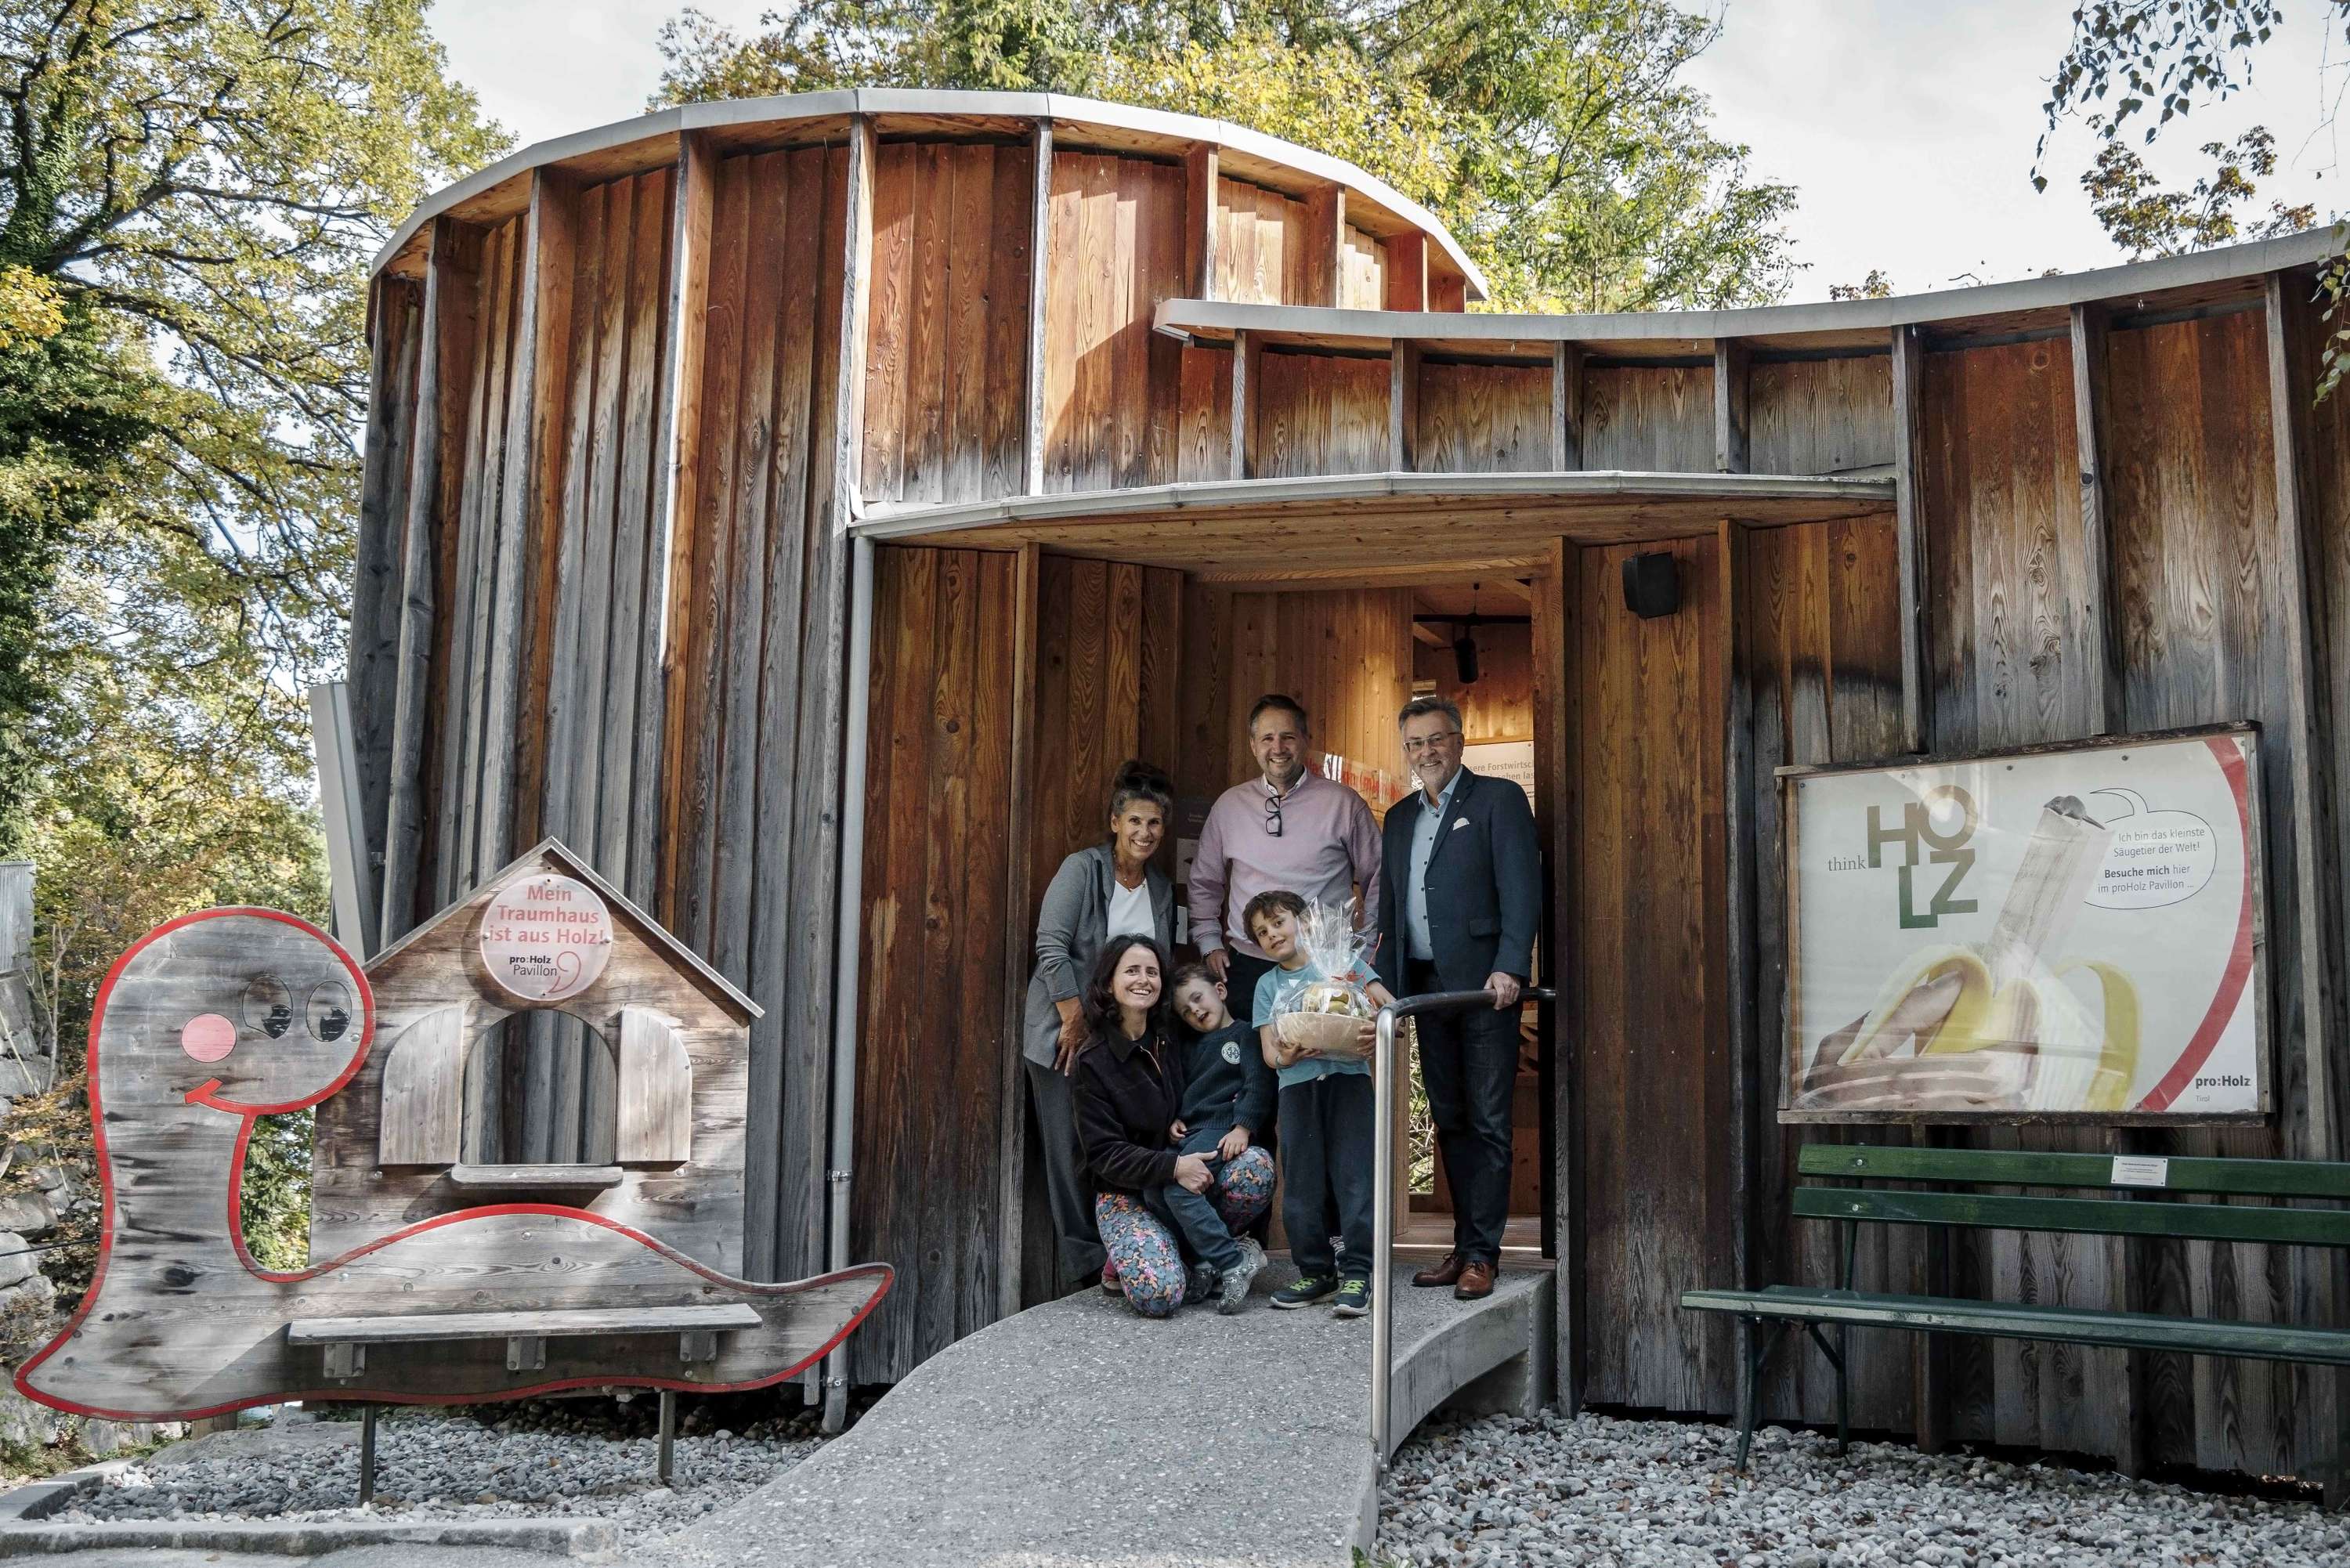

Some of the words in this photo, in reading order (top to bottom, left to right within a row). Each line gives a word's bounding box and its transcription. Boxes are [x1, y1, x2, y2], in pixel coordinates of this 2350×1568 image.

[1488, 761, 1534, 771] Forstwirtsc
[2119, 833, 2131, 842] Ich
[2135, 831, 2149, 840] bin
[2151, 830, 2167, 840] das
[2170, 828, 2205, 838] kleinste
[2114, 846, 2156, 858] Säugetier
[2158, 844, 2173, 854] der
[2175, 842, 2200, 852] Welt!
[1828, 855, 1866, 871] think
[2105, 867, 2143, 878] Besuche
[2146, 865, 2170, 876] mich
[2173, 865, 2191, 874] hier
[527, 885, 572, 901] Mein
[2098, 883, 2109, 893] im
[2112, 882, 2146, 894] proHolz
[2149, 880, 2184, 891] Pavillon
[497, 905, 599, 923] Traumhaus
[490, 925, 512, 941] ist
[518, 930, 549, 943] aus
[557, 928, 605, 945] Holz!
[513, 964, 557, 977] Pavillon
[2196, 1075, 2251, 1089] pro:Holz
